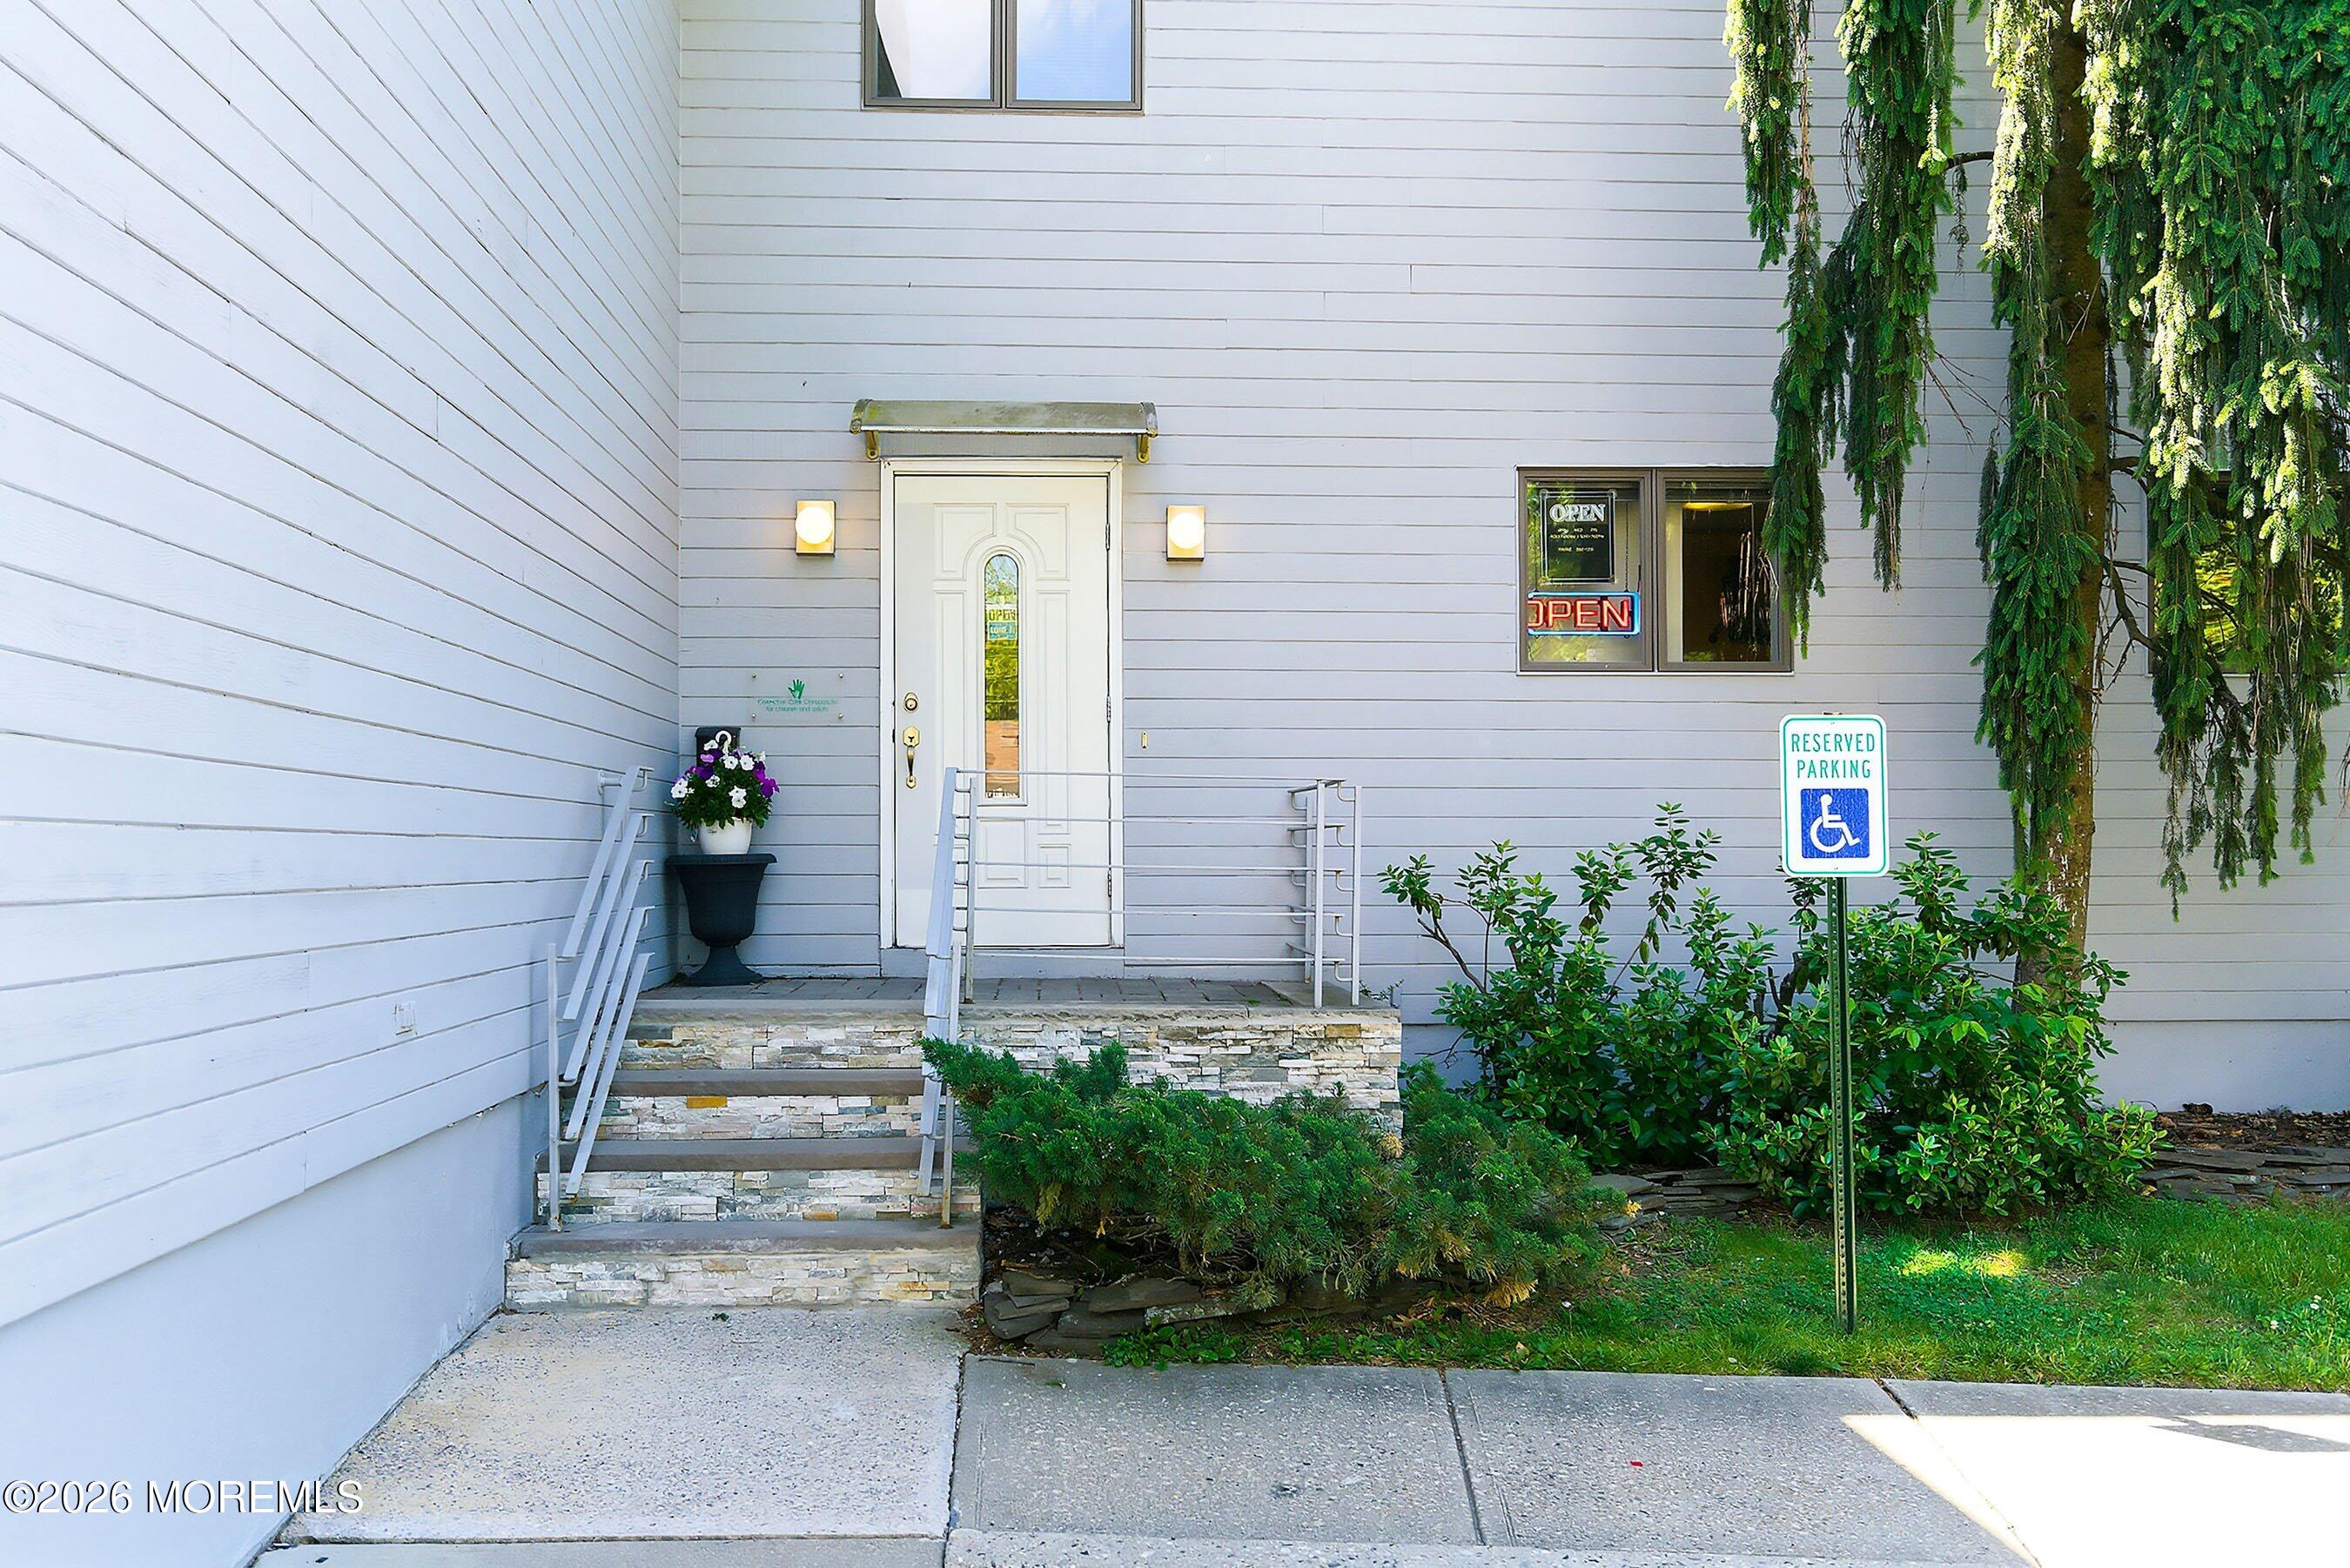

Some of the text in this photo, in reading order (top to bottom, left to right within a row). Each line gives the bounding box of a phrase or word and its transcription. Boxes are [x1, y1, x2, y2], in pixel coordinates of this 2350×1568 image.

[1549, 504, 1606, 522] OPEN
[1791, 734, 1875, 752] RESERVED
[1797, 760, 1870, 778] PARKING
